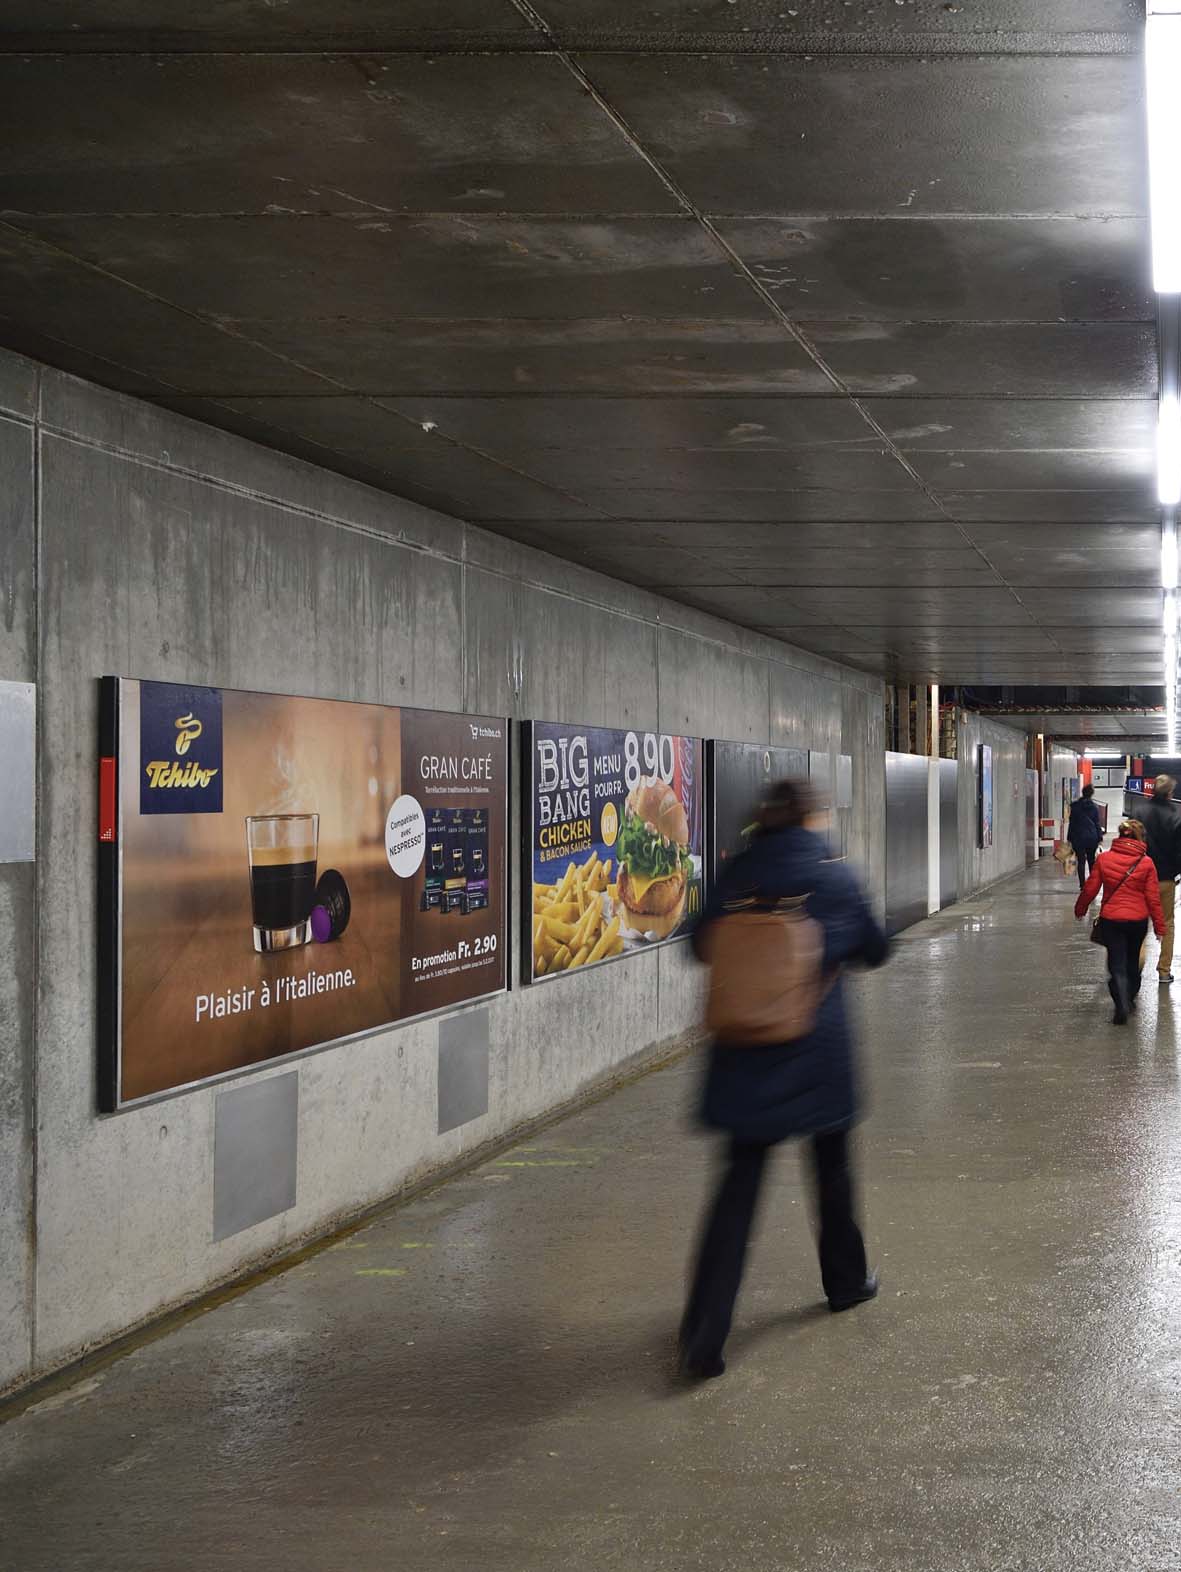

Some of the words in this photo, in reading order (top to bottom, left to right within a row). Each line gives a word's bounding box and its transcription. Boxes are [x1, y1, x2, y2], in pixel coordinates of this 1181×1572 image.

[145, 760, 219, 788] Tchibo
[420, 755, 458, 779] GRAN
[461, 752, 493, 780] CAFÉ
[537, 735, 590, 793] BIG
[593, 753, 621, 776] MENU
[594, 782, 613, 798] POUR
[613, 780, 624, 795] FR.
[390, 811, 420, 831] Compatibles
[538, 788, 591, 826] BANG
[400, 827, 412, 838] avec
[539, 818, 591, 849] CHICKEN
[539, 852, 546, 863] &
[545, 845, 570, 861] BACON
[570, 839, 592, 855] SAUCE
[411, 957, 422, 971] En
[422, 950, 457, 971] promotion
[458, 941, 472, 960] Fr.
[474, 934, 497, 956] 2.90
[195, 985, 256, 1023] Plaisir
[260, 980, 271, 1007] à
[276, 968, 356, 1003] l'italienne.
